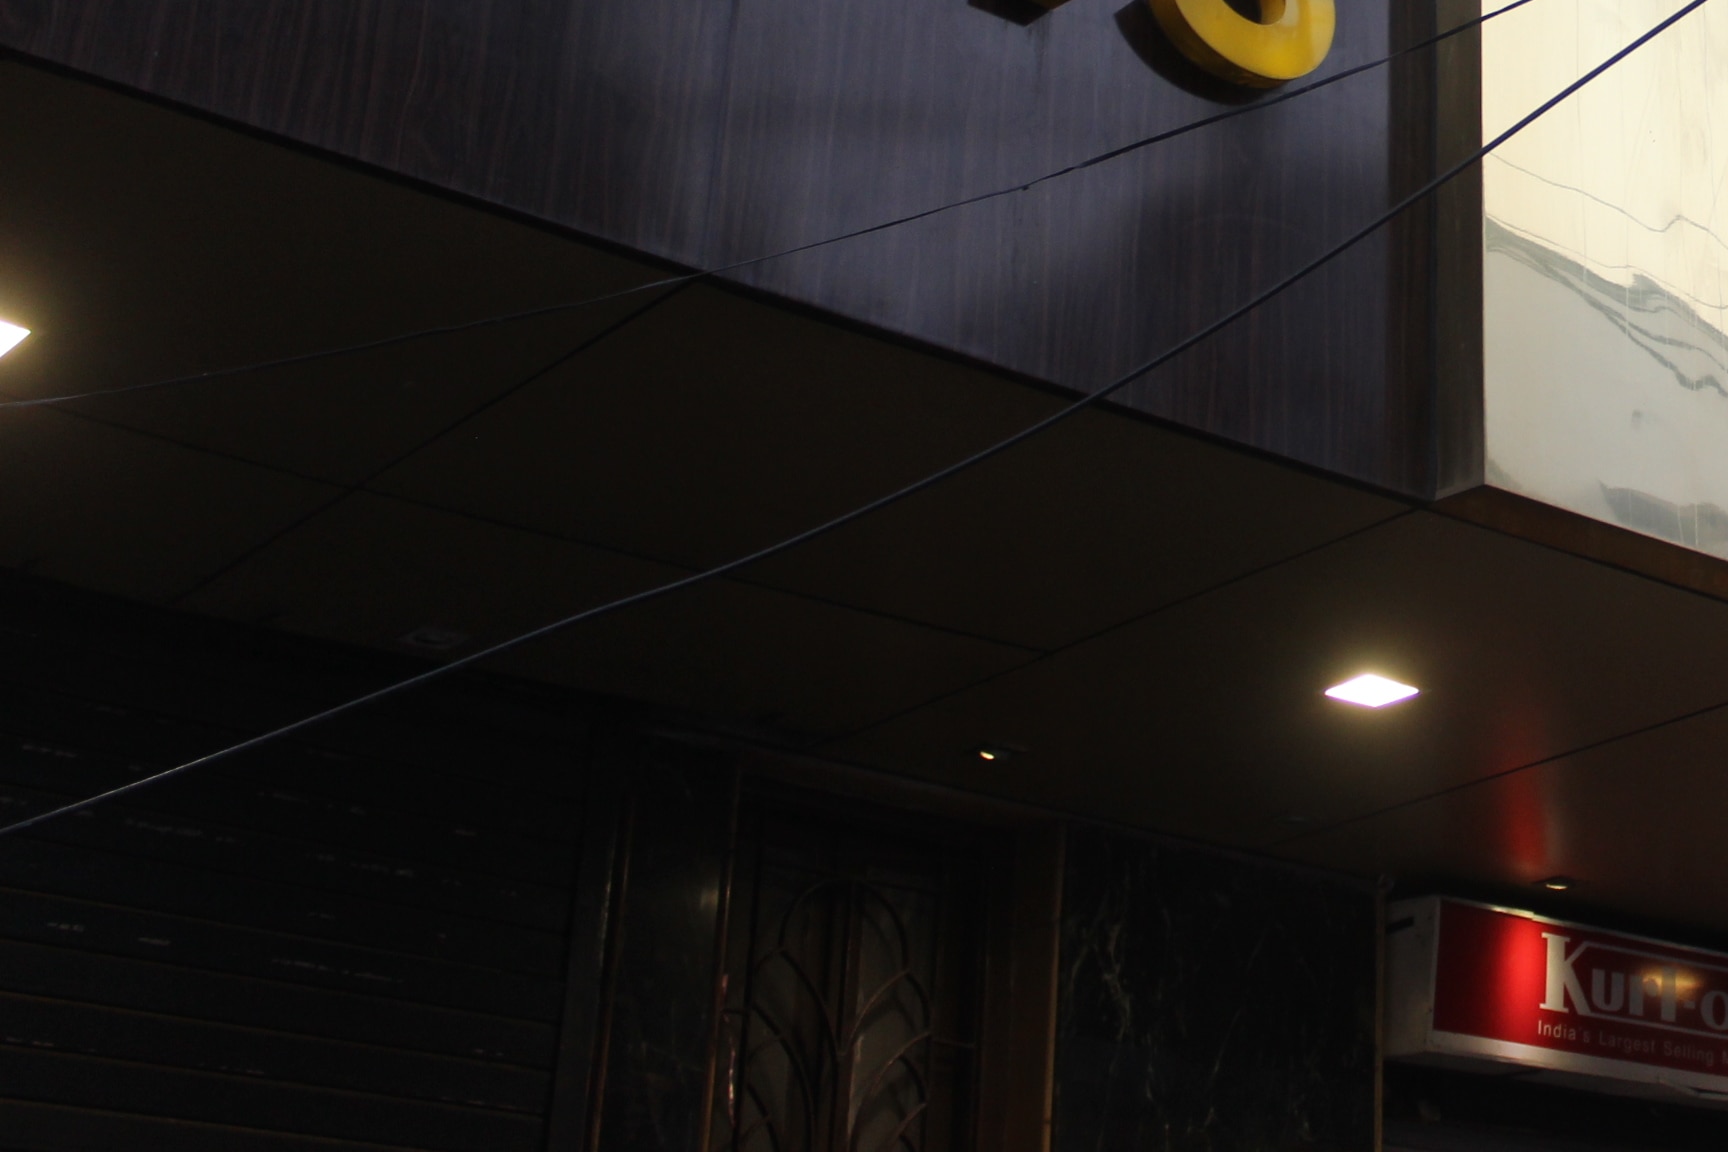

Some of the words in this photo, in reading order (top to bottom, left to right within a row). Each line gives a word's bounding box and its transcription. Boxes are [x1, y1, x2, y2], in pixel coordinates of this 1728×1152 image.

[1537, 1019, 1591, 1043] India's
[1599, 1031, 1656, 1054] Largest
[1663, 1040, 1714, 1066] Selling
